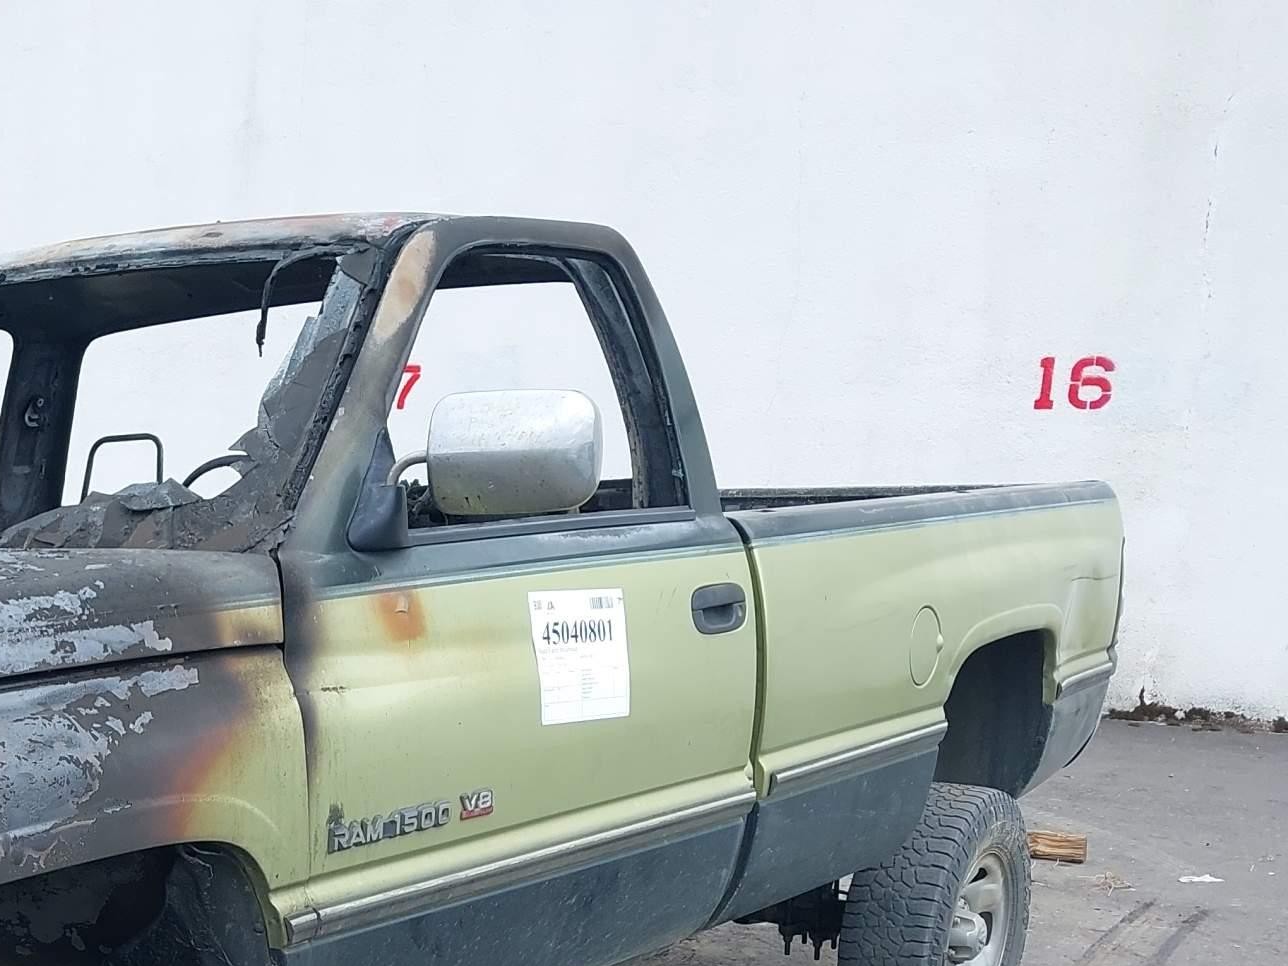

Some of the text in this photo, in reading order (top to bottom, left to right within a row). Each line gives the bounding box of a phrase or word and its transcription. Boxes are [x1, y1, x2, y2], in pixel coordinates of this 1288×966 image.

[1033, 356, 1115, 409] 16
[542, 618, 613, 645] 45040801
[330, 814, 384, 852] RAM
[387, 800, 452, 838] 1500
[460, 789, 494, 812] V8
